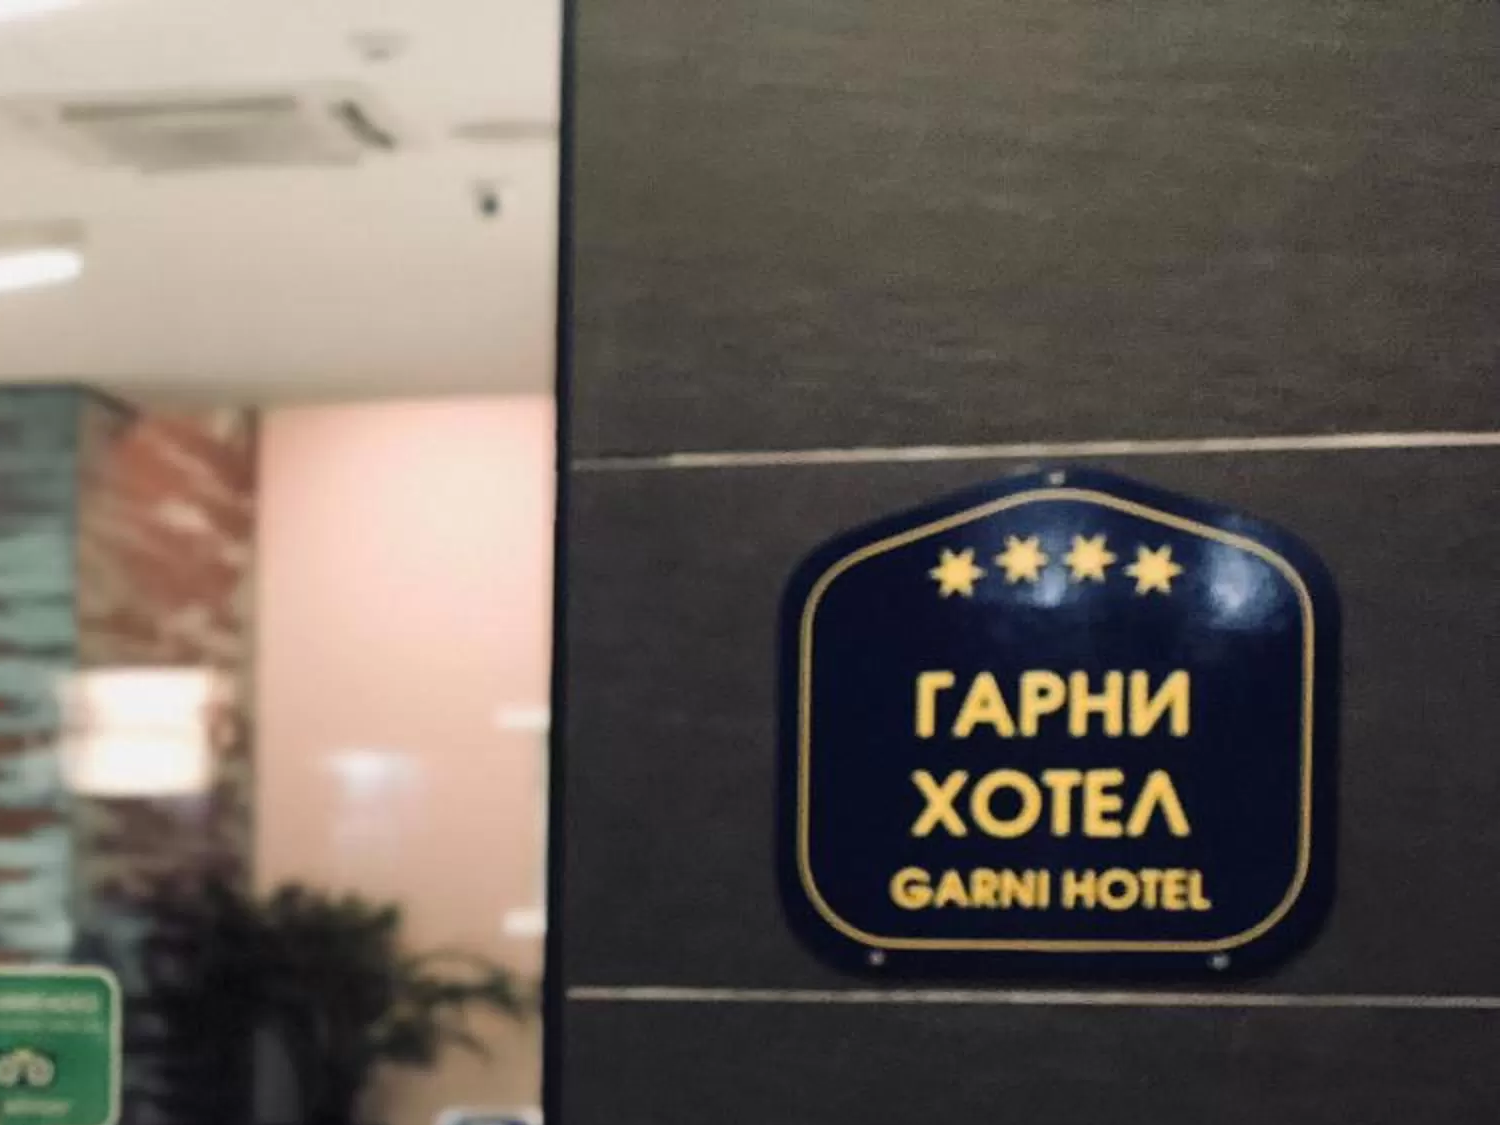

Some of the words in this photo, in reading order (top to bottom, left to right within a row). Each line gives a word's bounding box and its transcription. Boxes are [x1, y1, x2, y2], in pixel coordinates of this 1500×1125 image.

[915, 670, 1191, 738] ГАРНИ
[911, 768, 1192, 838] ХОТЕЛ
[890, 866, 1050, 911] GARNI
[1062, 868, 1211, 911] HOTEL
